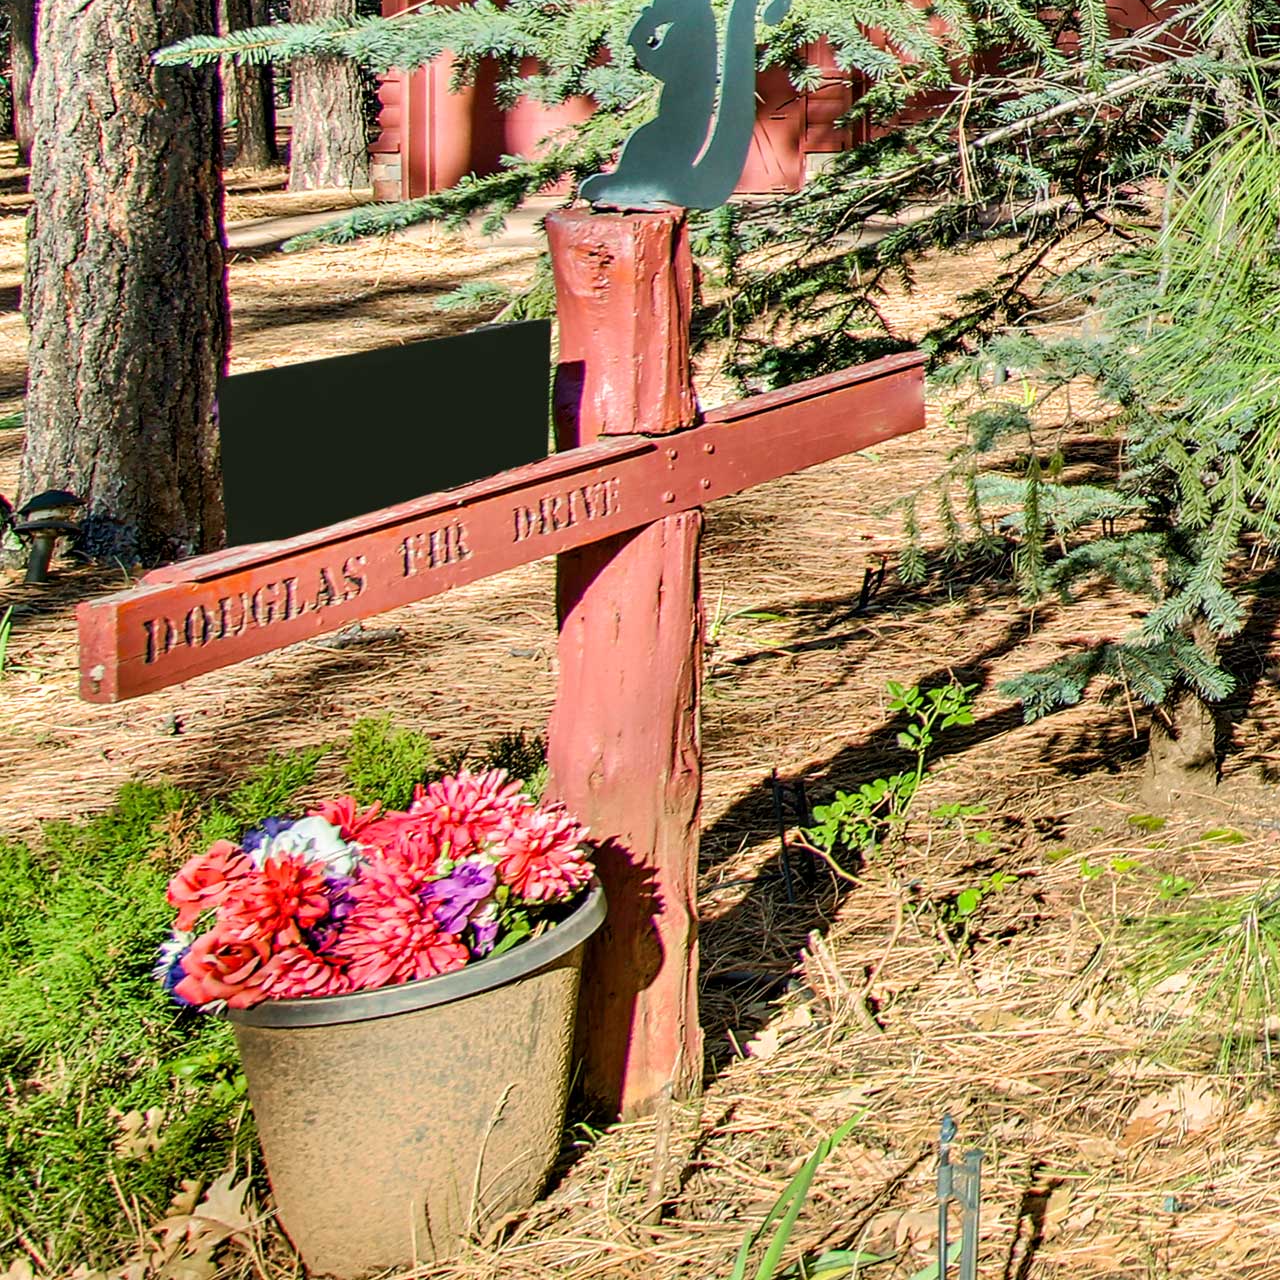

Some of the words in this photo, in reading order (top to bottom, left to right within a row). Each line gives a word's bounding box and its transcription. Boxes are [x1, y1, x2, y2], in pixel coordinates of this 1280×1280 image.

[143, 554, 368, 664] DOUGLAS
[401, 521, 472, 577] FIR
[512, 477, 621, 543] DRIVE
